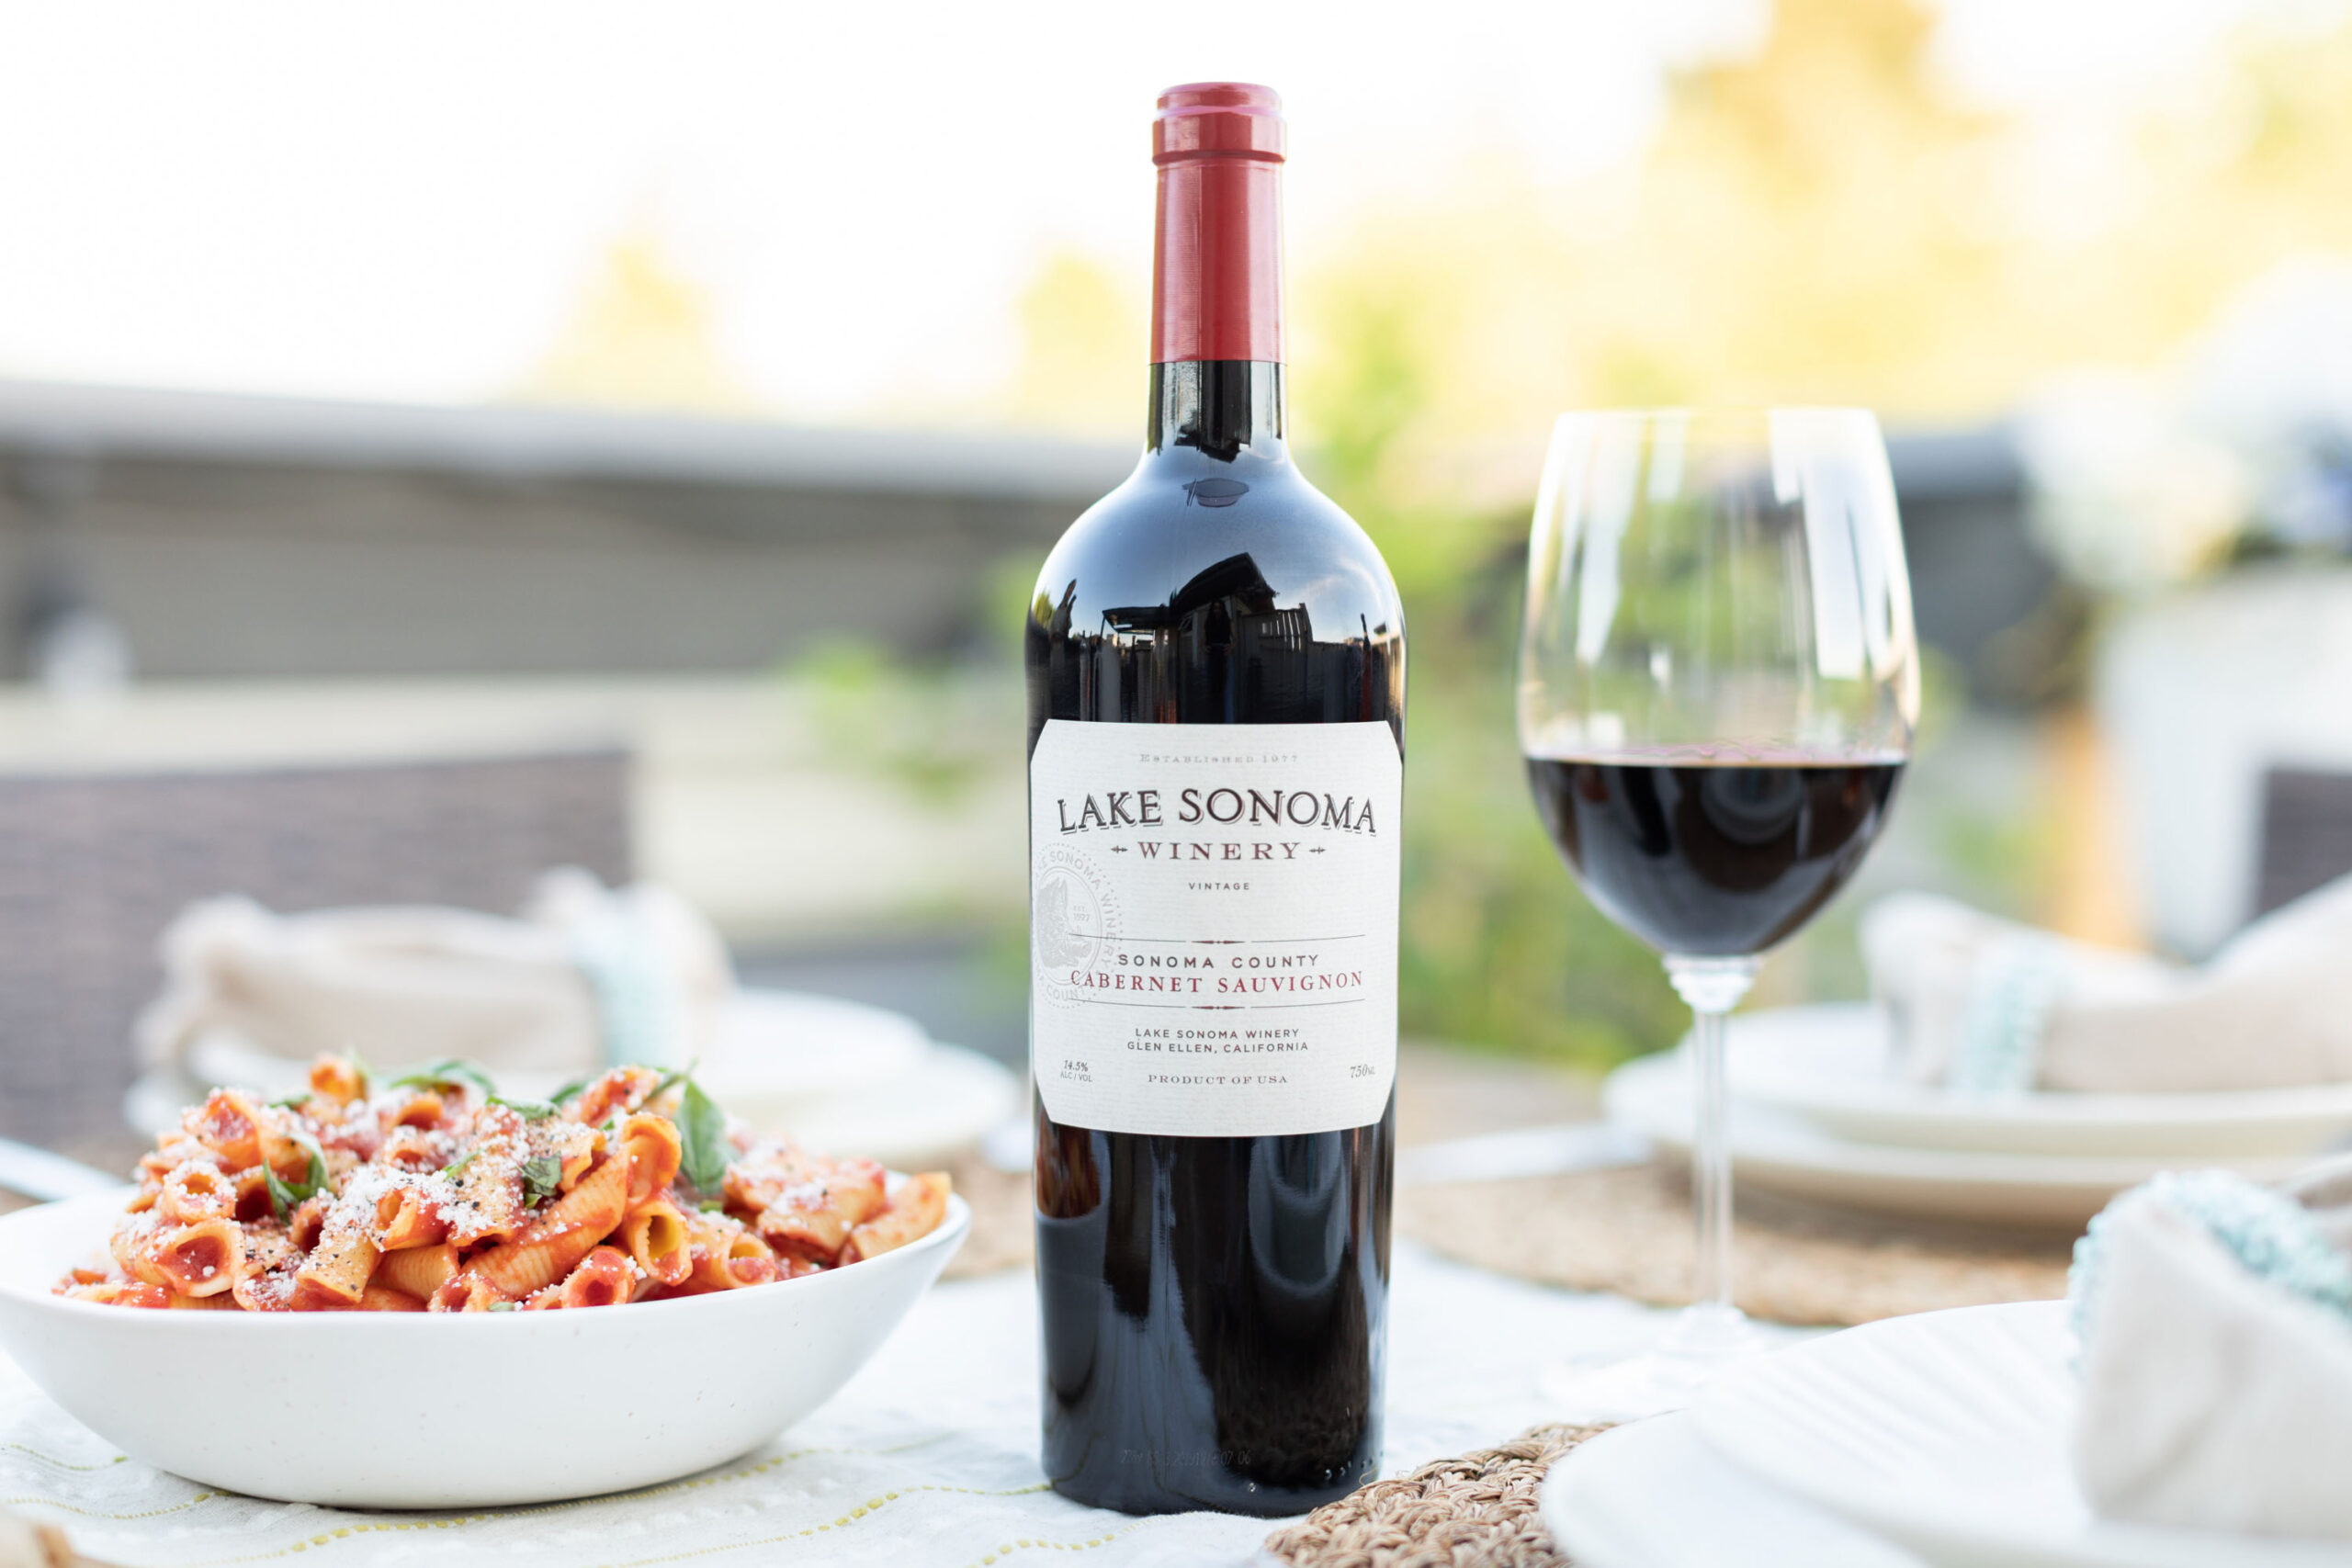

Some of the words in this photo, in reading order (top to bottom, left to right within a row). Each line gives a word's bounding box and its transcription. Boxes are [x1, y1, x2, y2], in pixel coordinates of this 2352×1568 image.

[1262, 754, 1298, 764] 1977
[1057, 789, 1165, 836] LAKE
[1178, 787, 1377, 838] SONOMA
[1137, 840, 1301, 861] WINERY
[1188, 882, 1250, 891] VINTAGE
[1049, 850, 1102, 890] SONOMA
[1100, 892, 1117, 969] WINERY
[1118, 953, 1215, 969] SONOMA
[1231, 953, 1319, 969] COUNTY
[1070, 970, 1203, 993] CABERNET
[1216, 970, 1363, 994] SAUVIGNON
[1135, 1028, 1170, 1039] LAKE
[1176, 1029, 1238, 1040] SONOMA
[1245, 1028, 1300, 1040] WINERY
[1126, 1041, 1162, 1052] GLEN
[1168, 1043, 1218, 1055] ELLEN,
[1223, 1042, 1308, 1054] CALIFORNIA
[1063, 1059, 1089, 1072] 14.5%
[1148, 1074, 1227, 1085] PRODUCT
[1230, 1076, 1253, 1085] OF
[1257, 1075, 1288, 1085] USA
